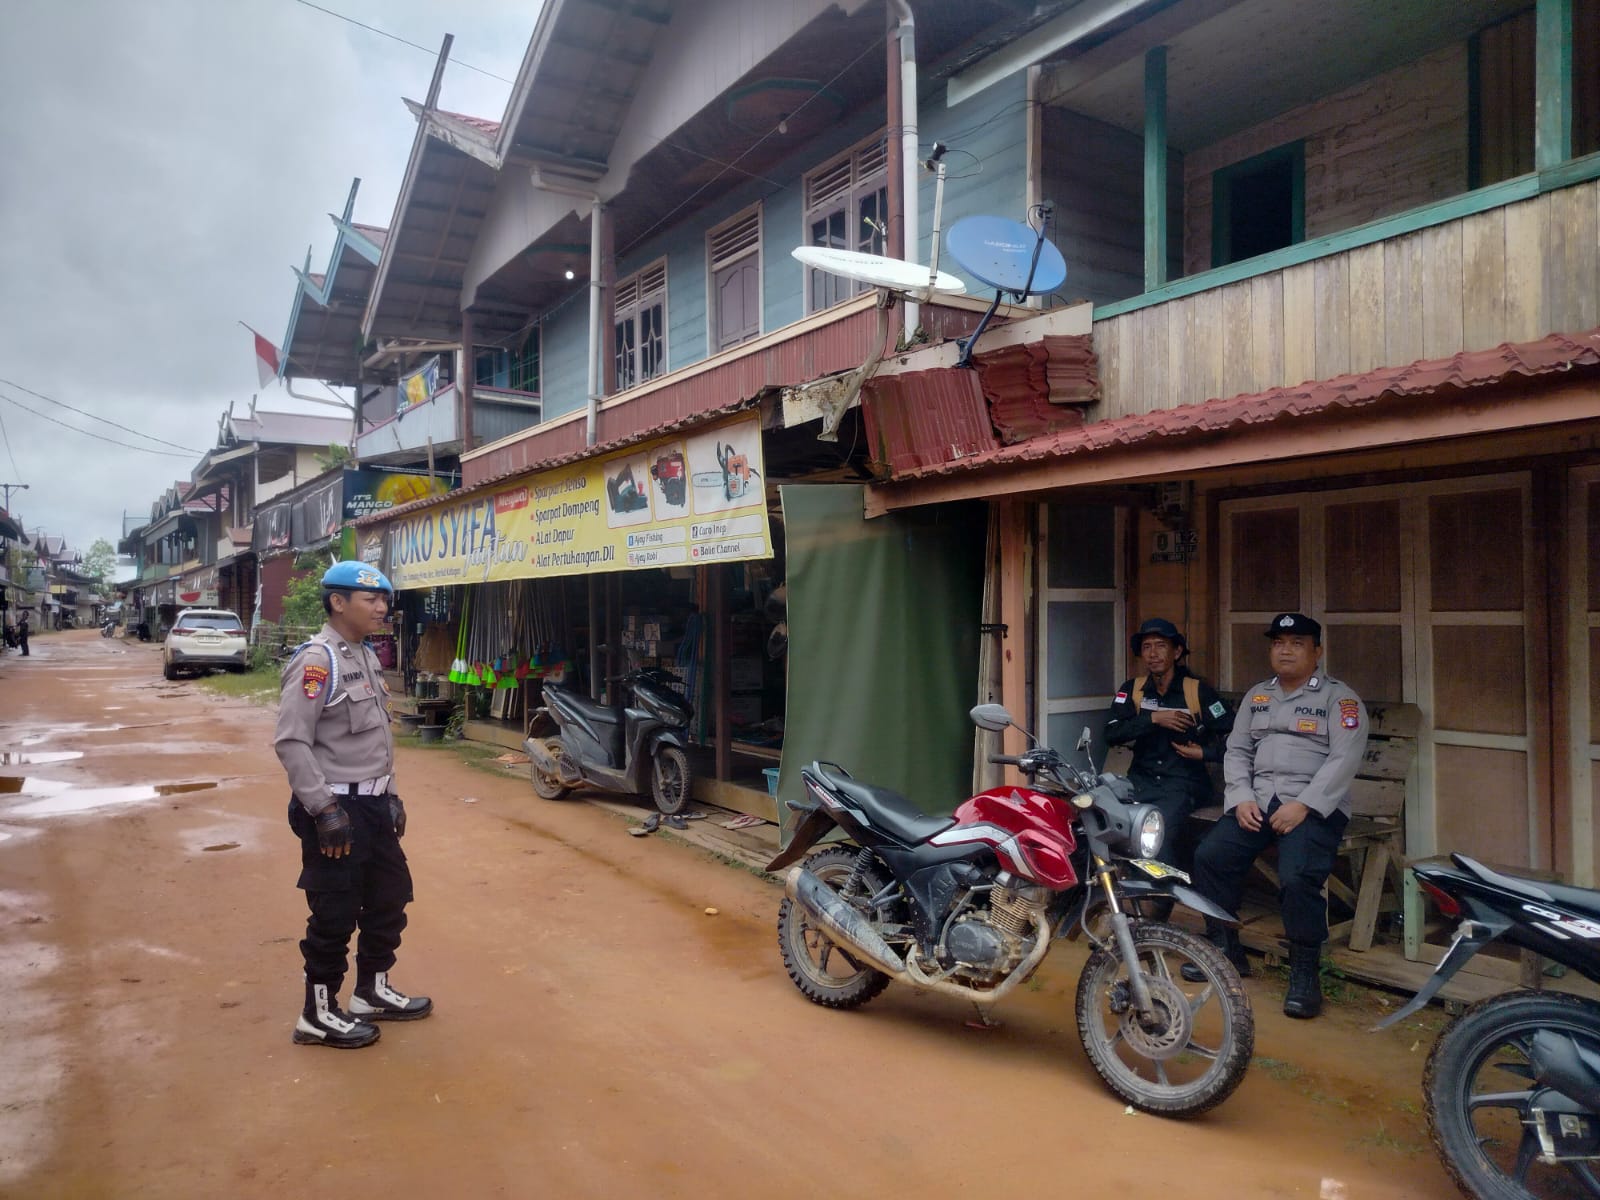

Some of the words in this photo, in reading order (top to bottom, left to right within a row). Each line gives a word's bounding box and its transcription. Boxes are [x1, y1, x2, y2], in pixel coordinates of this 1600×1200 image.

[346, 500, 393, 509] MANGO
[562, 499, 600, 520] Dompeng
[389, 512, 434, 570] TOKO
[438, 494, 496, 559] SYIFA
[553, 529, 575, 546] Dapur
[1294, 706, 1327, 718] POLRI
